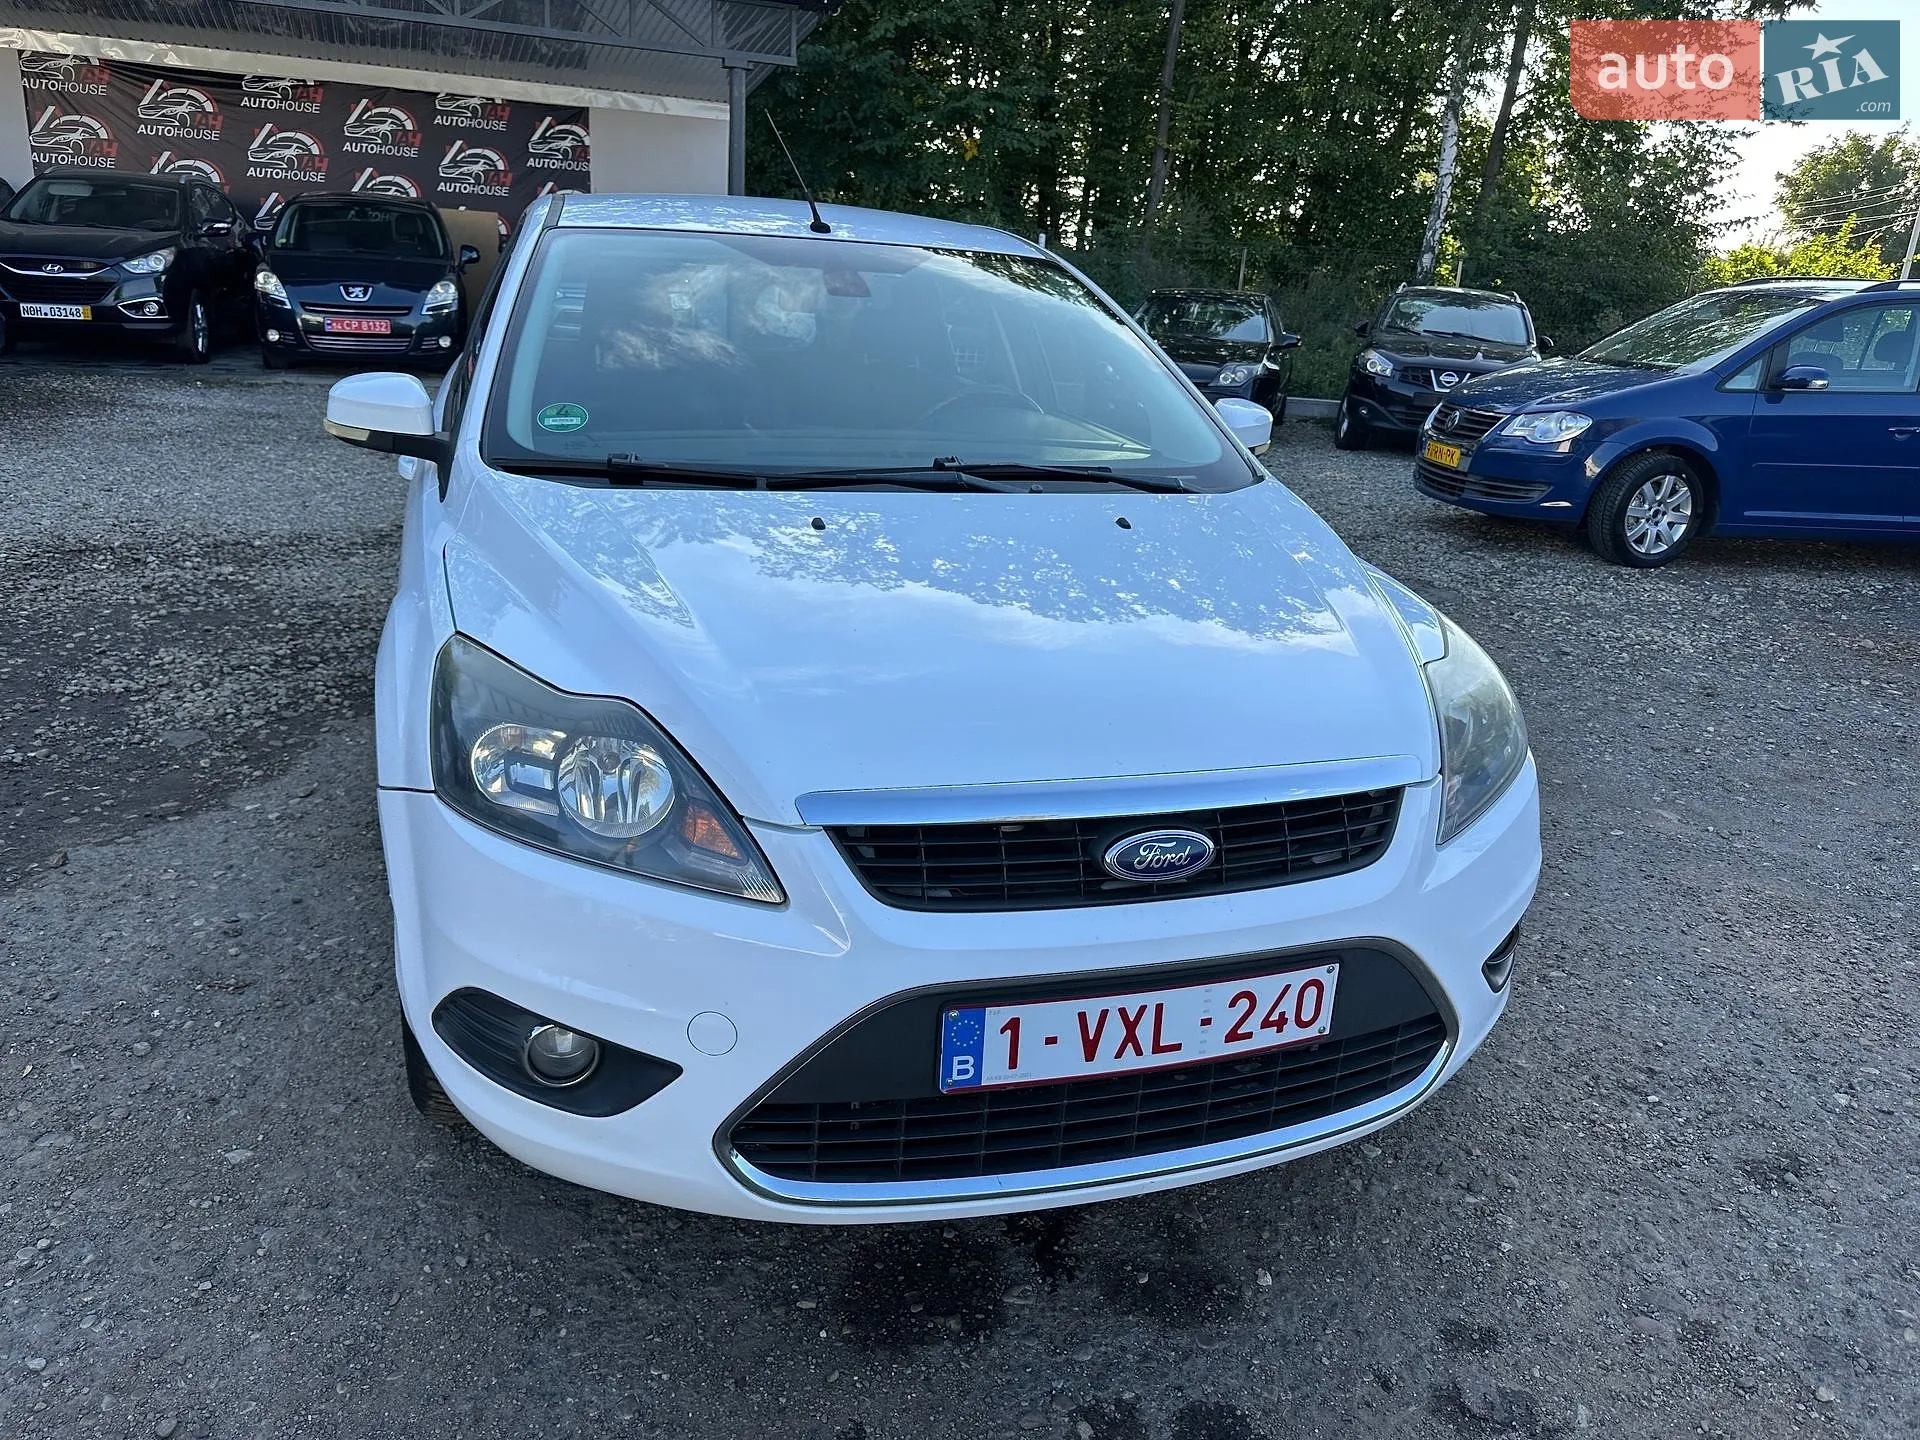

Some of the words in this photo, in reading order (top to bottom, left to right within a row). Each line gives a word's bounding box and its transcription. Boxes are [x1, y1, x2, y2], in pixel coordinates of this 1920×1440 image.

[21, 77, 107, 96] AUTOHOUSE
[240, 96, 321, 114] AUTOHOUSE
[137, 123, 221, 141] AUTOHOUSE
[433, 114, 508, 132] AUTOHOUSE
[342, 141, 419, 158] AUTOHOUSE
[31, 151, 116, 169] AUTOHOUSE
[246, 166, 327, 183] AUTOHOUSE
[436, 181, 510, 197] AUTOHOUSE
[1133, 841, 1192, 870] Ford
[952, 1055, 975, 1081] B
